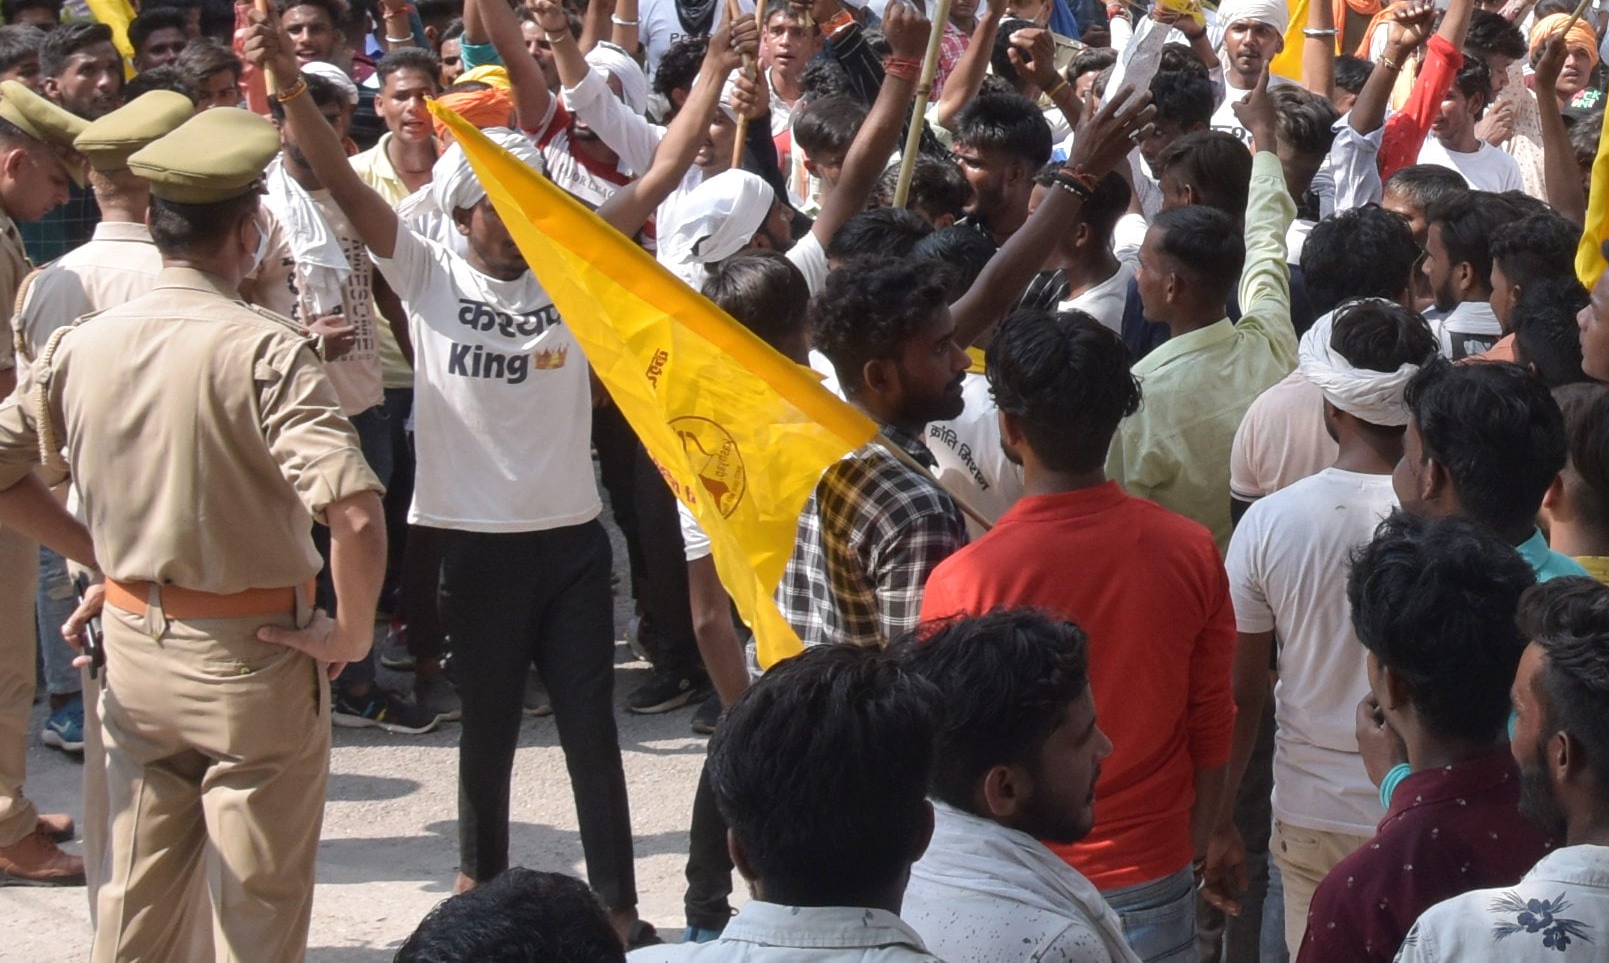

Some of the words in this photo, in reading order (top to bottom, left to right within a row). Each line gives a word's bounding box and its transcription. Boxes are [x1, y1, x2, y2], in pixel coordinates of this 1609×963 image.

[448, 342, 530, 384] King
[930, 425, 958, 450] क्रांति
[958, 443, 989, 491] मिशन
